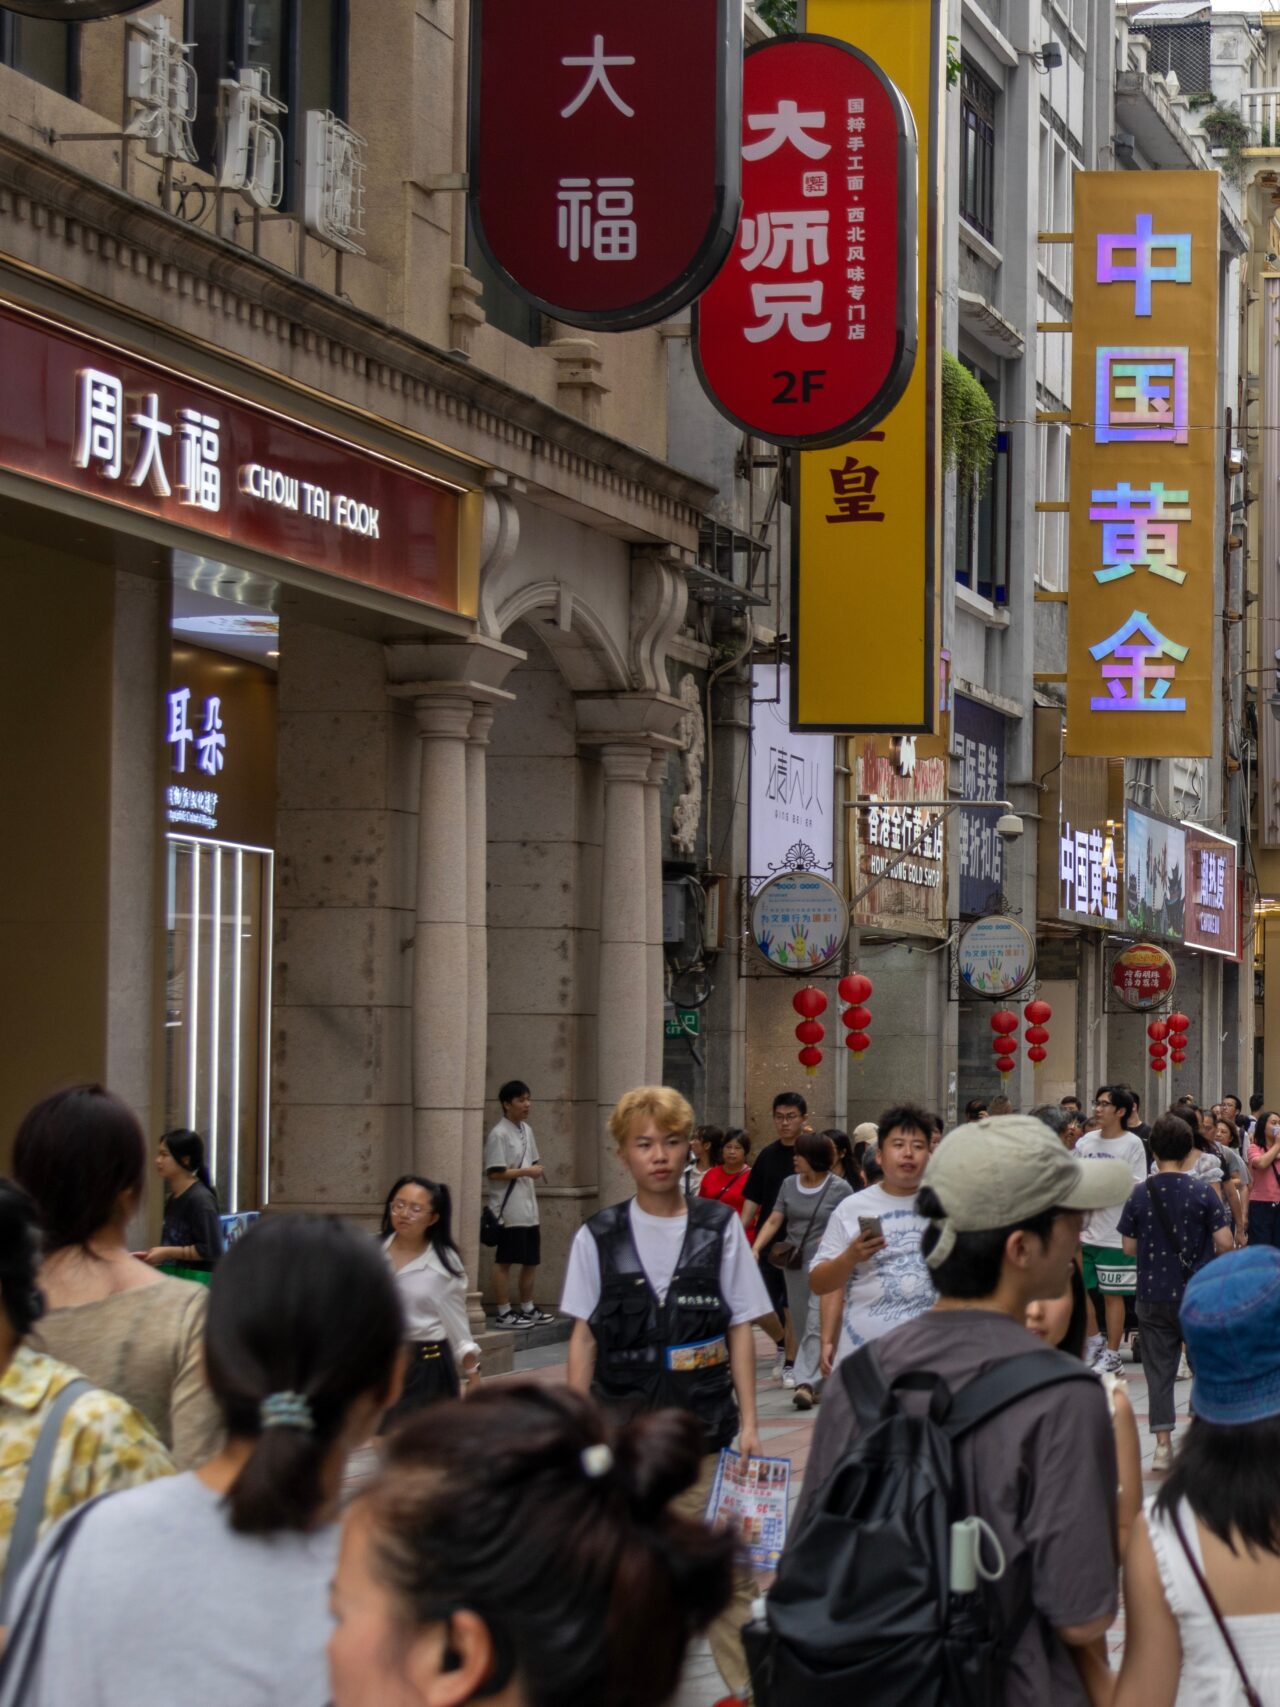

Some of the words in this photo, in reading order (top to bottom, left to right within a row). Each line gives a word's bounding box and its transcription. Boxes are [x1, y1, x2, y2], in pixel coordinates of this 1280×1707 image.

[557, 34, 637, 262] 大福
[741, 100, 832, 344] 大师兄
[77, 367, 221, 513] 周大福
[771, 370, 827, 405] 2F
[1089, 213, 1192, 711] 中国黄金
[245, 463, 299, 511] CHOW
[302, 481, 330, 522] TAI
[334, 494, 379, 540] FOOK
